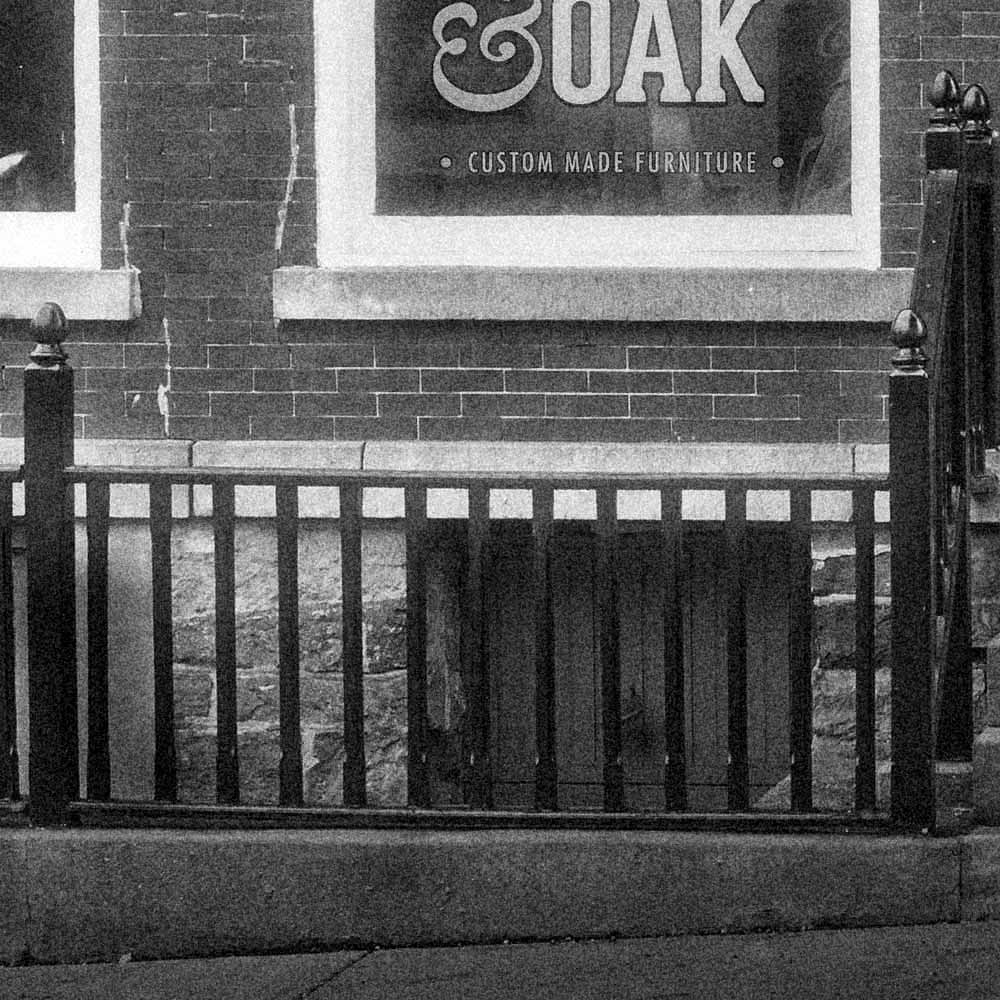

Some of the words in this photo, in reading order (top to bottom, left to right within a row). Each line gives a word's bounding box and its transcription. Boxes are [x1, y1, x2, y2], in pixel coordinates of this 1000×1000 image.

[468, 151, 553, 173] CUSTOM
[565, 151, 624, 173] MADE
[635, 151, 757, 173] FURNITURE
